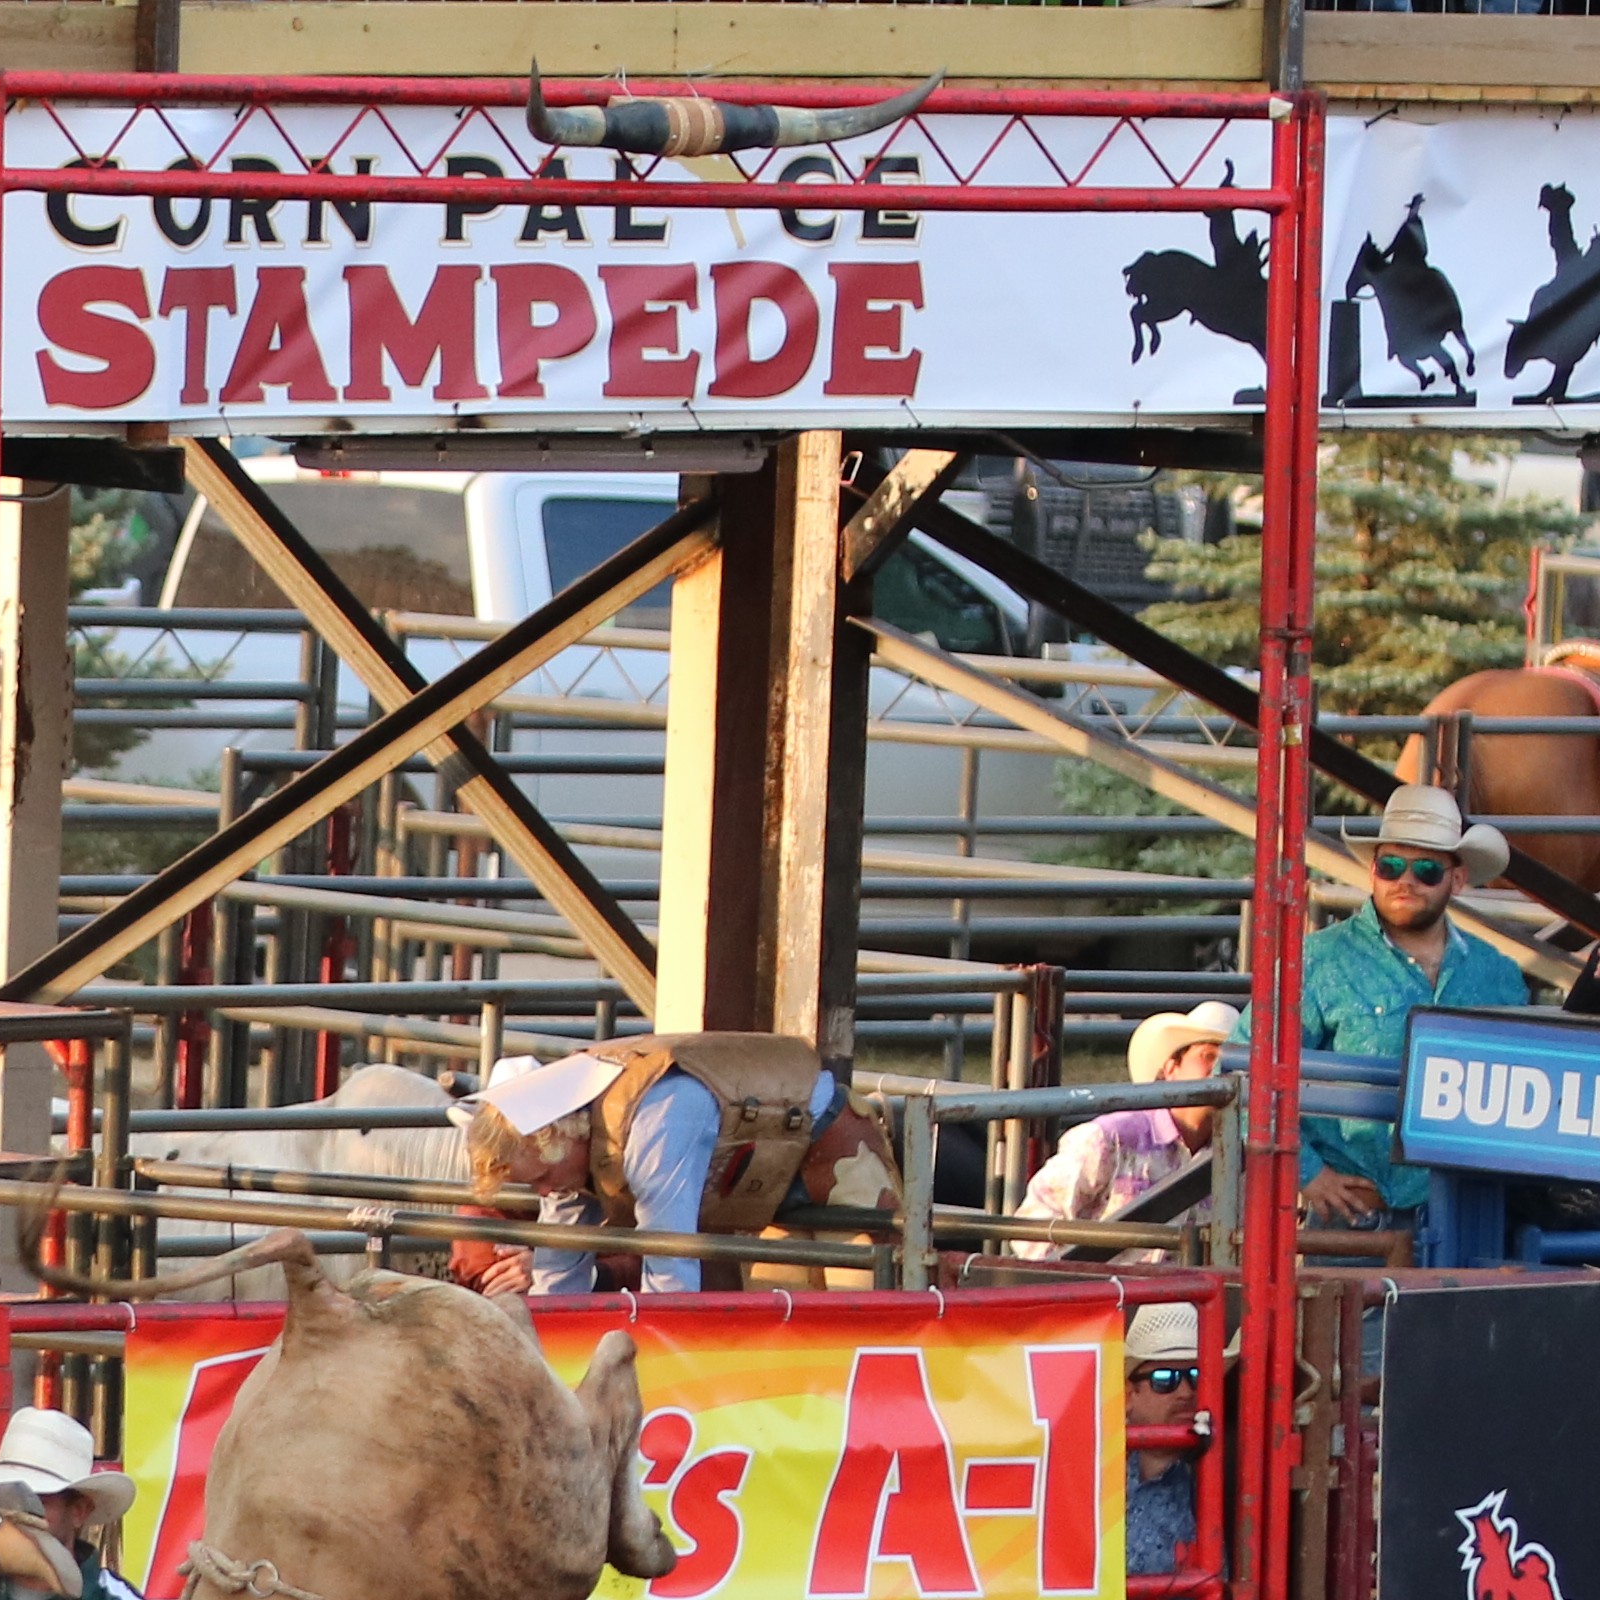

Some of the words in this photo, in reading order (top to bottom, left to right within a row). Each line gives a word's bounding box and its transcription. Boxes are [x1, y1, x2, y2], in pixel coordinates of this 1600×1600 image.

[46, 153, 378, 252] CORN
[35, 261, 926, 409] STAMPEDE
[1420, 1056, 1552, 1130] BUD
